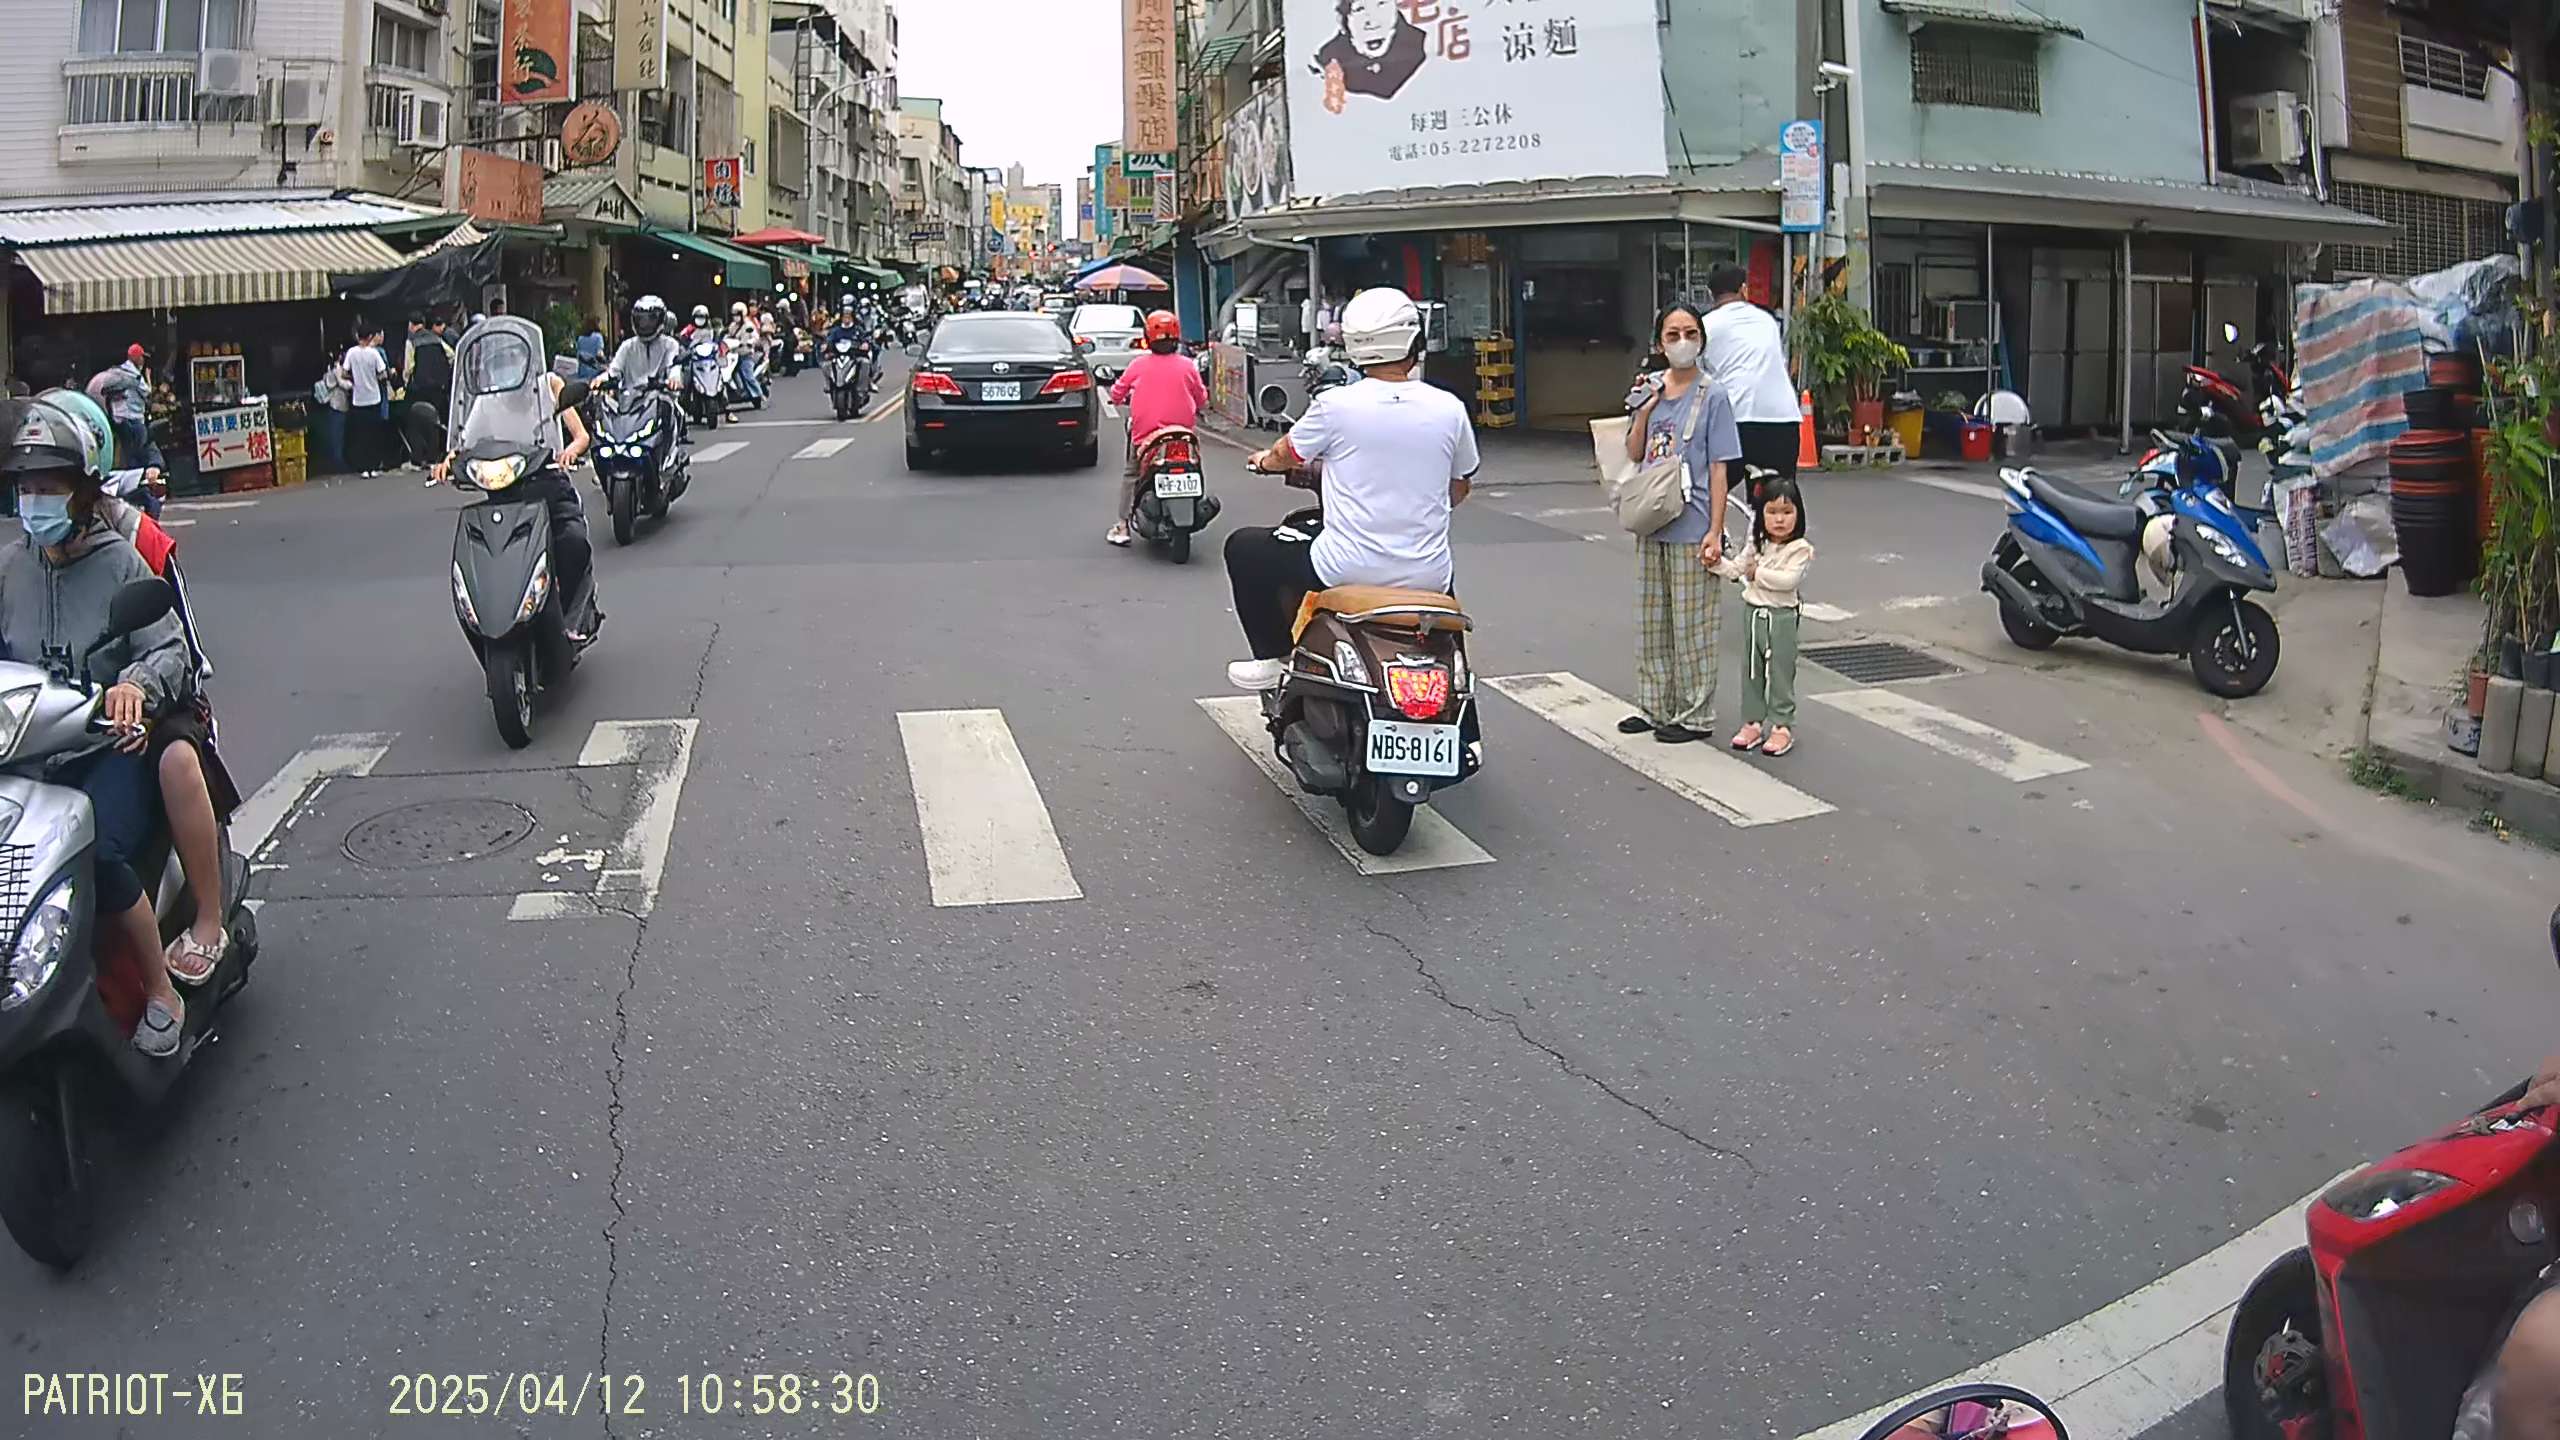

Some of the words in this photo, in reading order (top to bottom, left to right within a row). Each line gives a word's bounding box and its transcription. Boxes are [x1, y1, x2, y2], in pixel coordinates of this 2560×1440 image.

[1503, 16, 1578, 62] 涼麵
[1410, 103, 1513, 132] 每週三公休
[199, 431, 270, 467] 不一樣
[1370, 733, 1453, 764] NBS-8161
